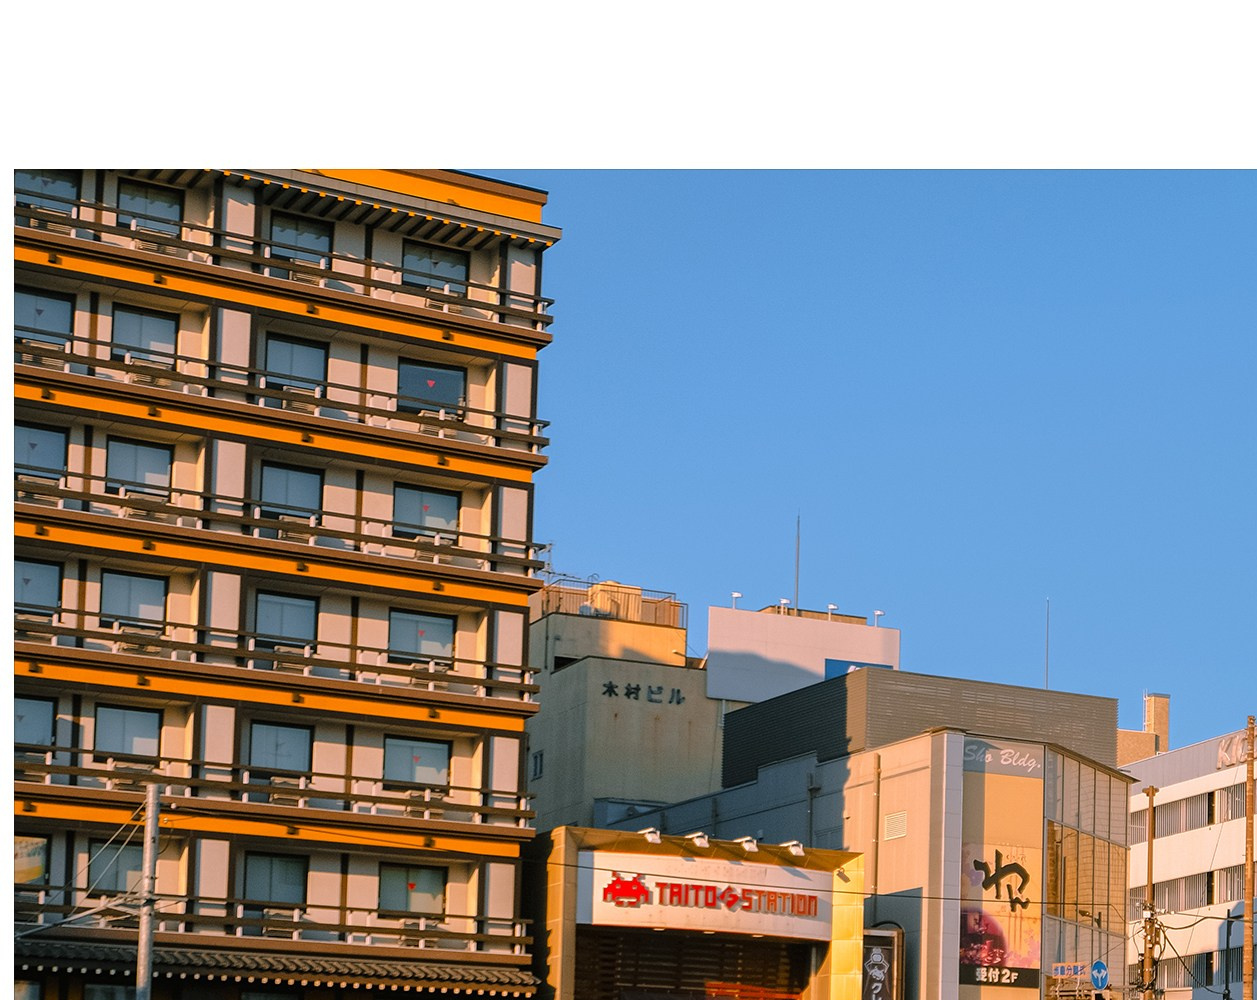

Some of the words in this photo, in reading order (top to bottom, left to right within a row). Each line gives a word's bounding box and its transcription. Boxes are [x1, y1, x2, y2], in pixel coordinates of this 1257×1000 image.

[602, 681, 686, 705] 木村ビル
[964, 745, 992, 763] Sho
[1000, 749, 1041, 774] Bldg.
[655, 882, 717, 907] TAITO
[741, 888, 818, 917] STATION
